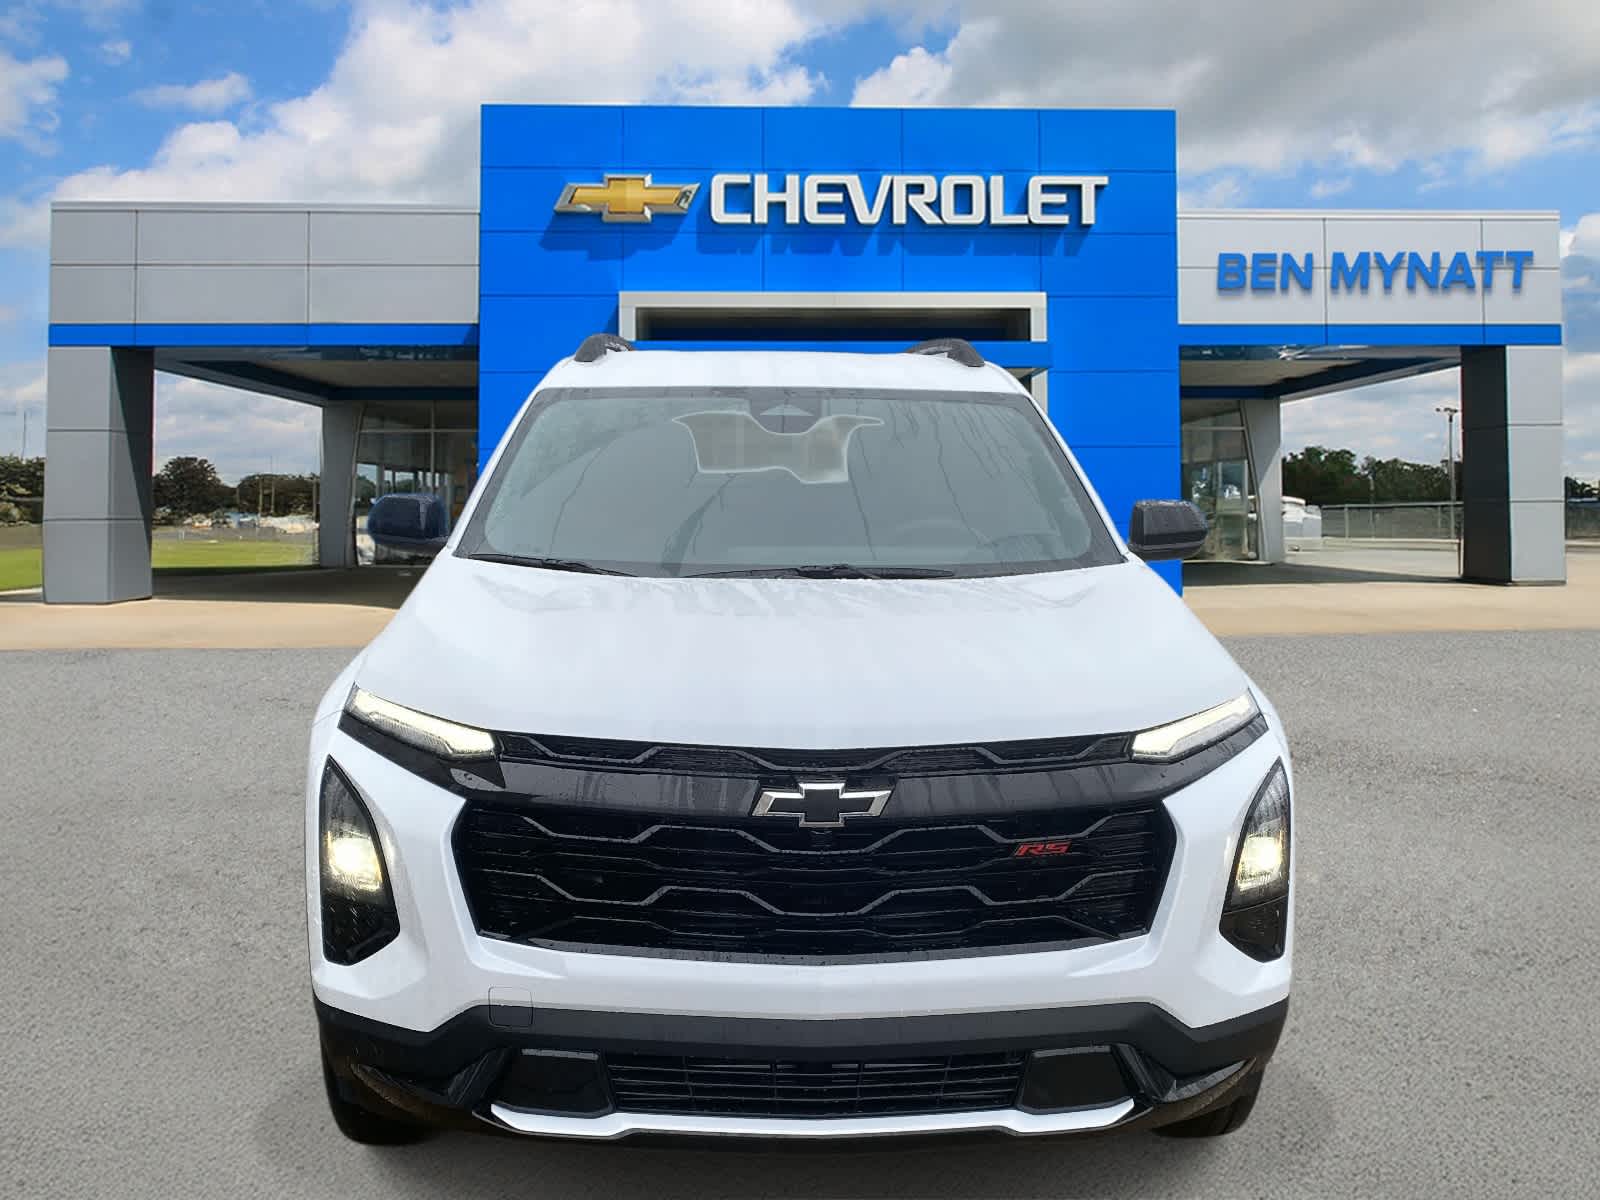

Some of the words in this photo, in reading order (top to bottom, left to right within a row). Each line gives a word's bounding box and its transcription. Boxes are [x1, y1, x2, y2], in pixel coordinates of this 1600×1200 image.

[710, 173, 1109, 226] CHEVROLET
[1216, 252, 1314, 292] BEN
[1329, 250, 1534, 292] MYNATT
[1014, 840, 1072, 857] RS
